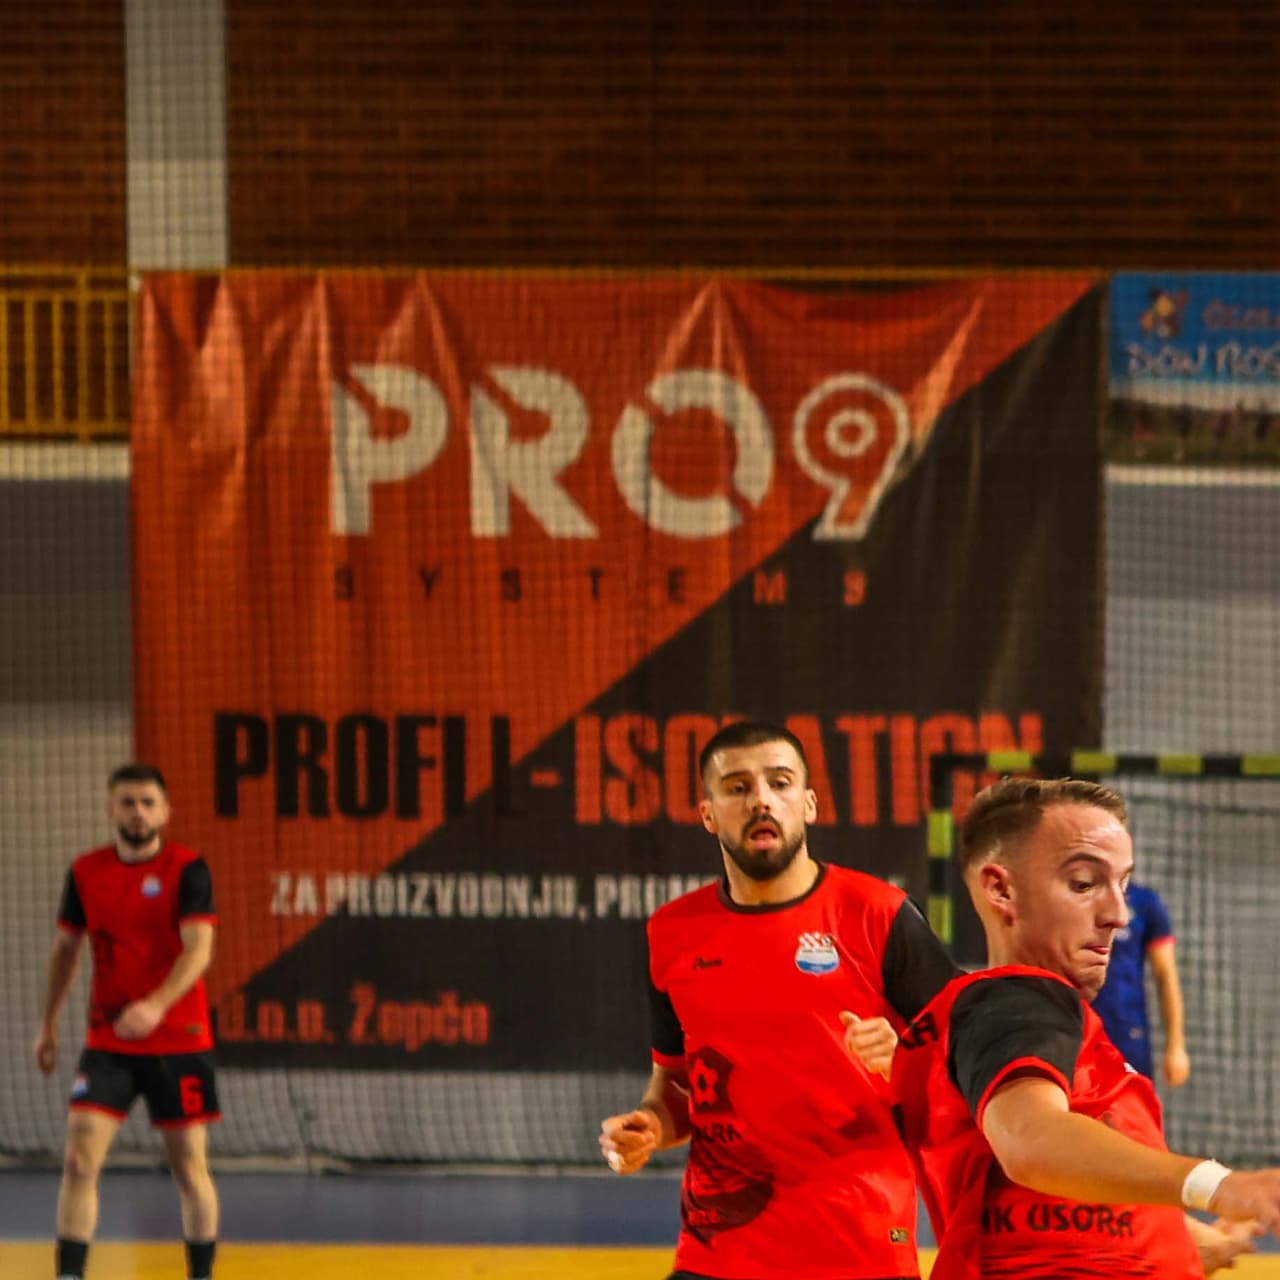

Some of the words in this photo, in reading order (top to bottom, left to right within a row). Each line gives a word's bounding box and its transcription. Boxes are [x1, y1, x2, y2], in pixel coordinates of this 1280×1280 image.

[330, 364, 911, 541] PRO9
[333, 568, 867, 606] SYSTEMS
[270, 870, 319, 917] ZA
[1026, 1202, 1134, 1238] USORA
